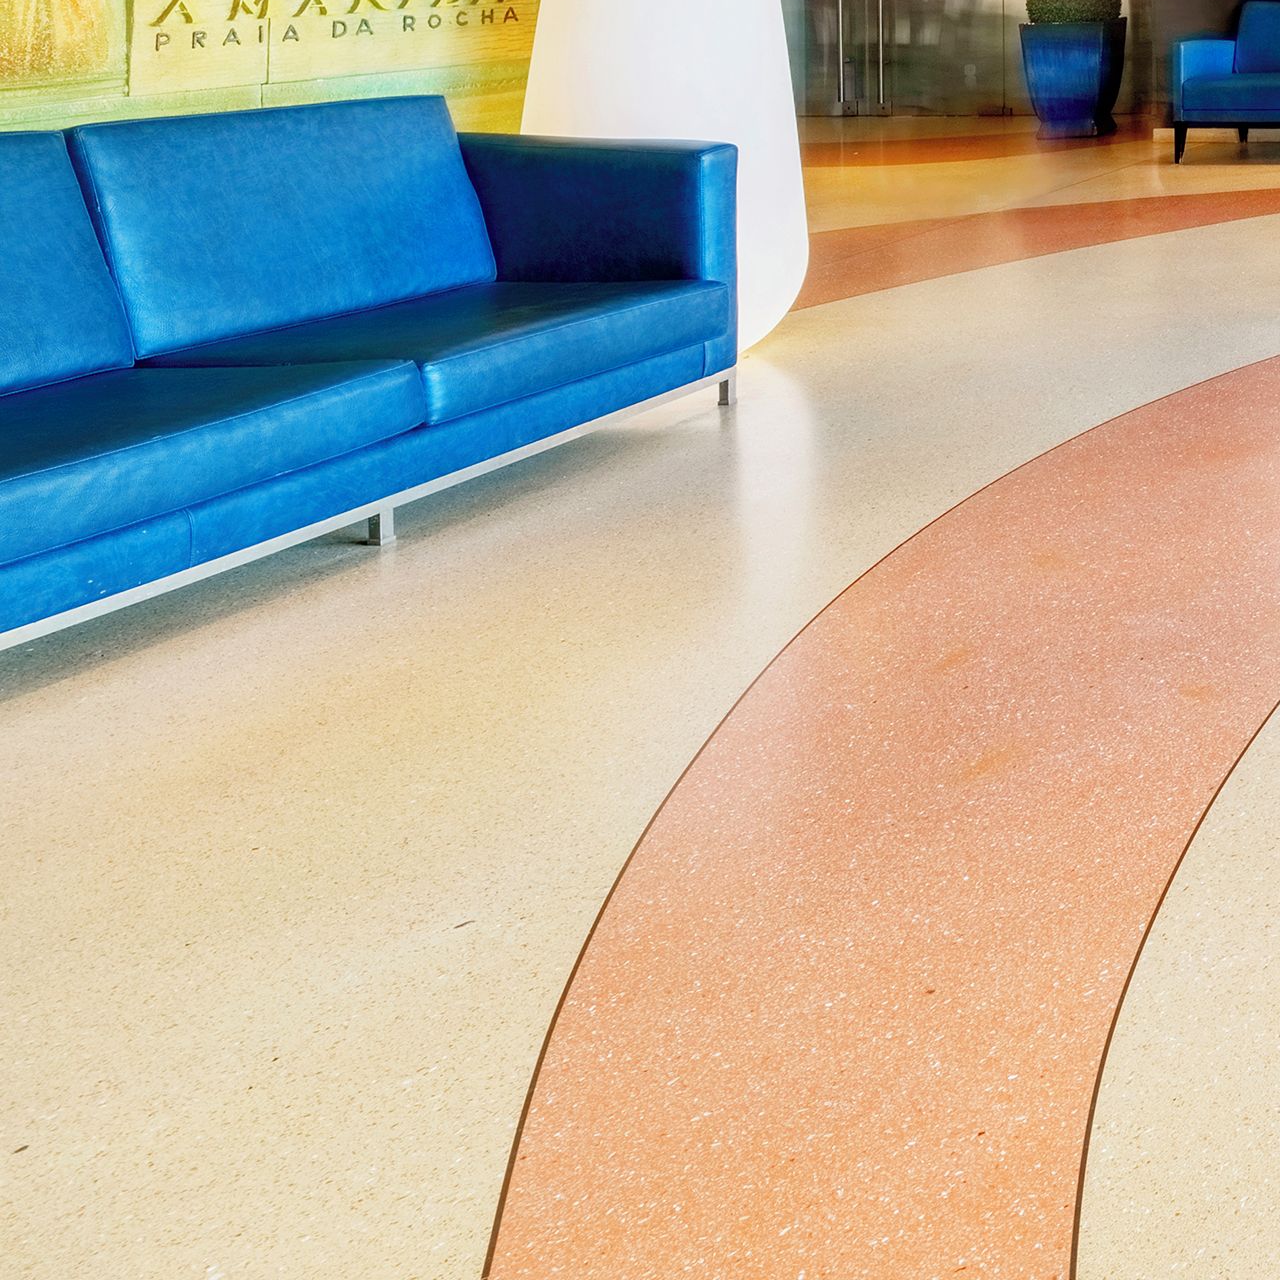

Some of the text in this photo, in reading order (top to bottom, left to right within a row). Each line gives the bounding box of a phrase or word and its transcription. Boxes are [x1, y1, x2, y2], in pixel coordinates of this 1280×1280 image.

[155, 6, 519, 51] PRAIA DA ROCHA
